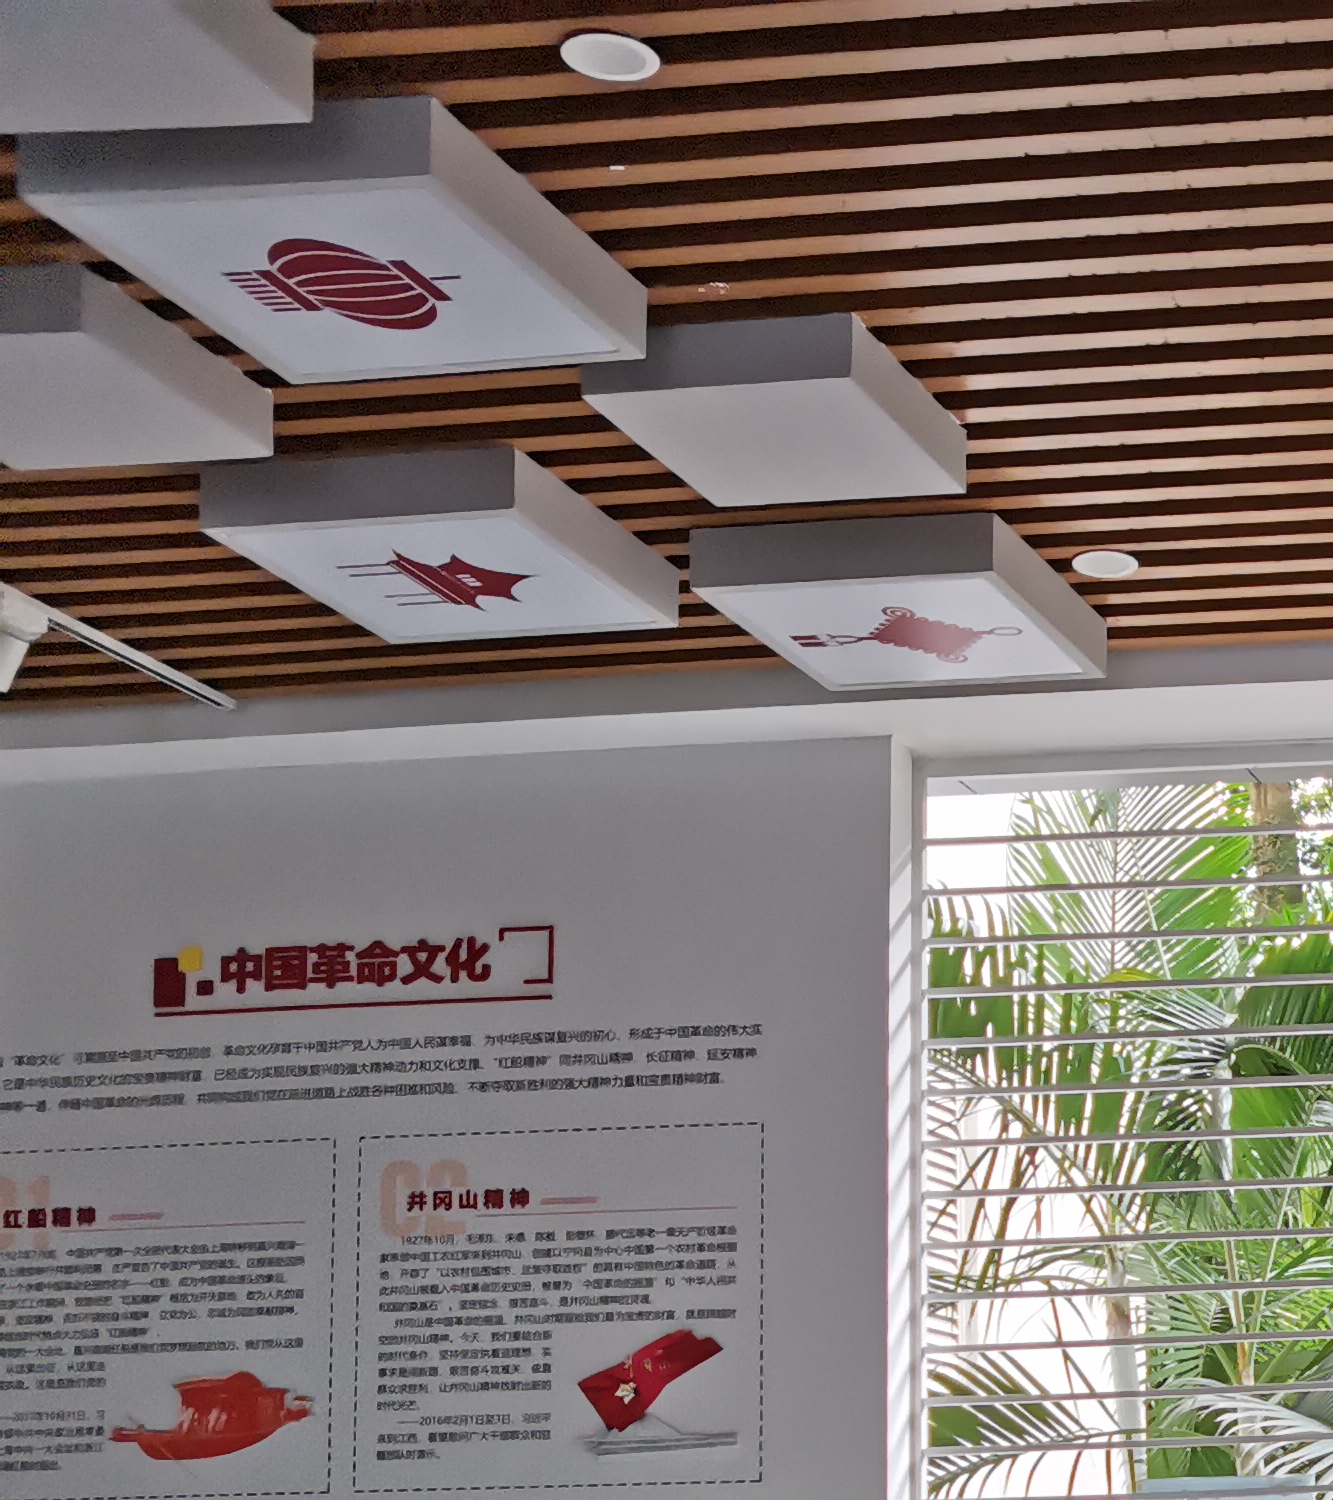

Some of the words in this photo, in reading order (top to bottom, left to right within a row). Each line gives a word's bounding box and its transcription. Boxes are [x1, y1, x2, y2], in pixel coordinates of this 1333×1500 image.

[220, 936, 491, 994] 中国革命文化
[406, 1187, 532, 1214] 井冈山精神
